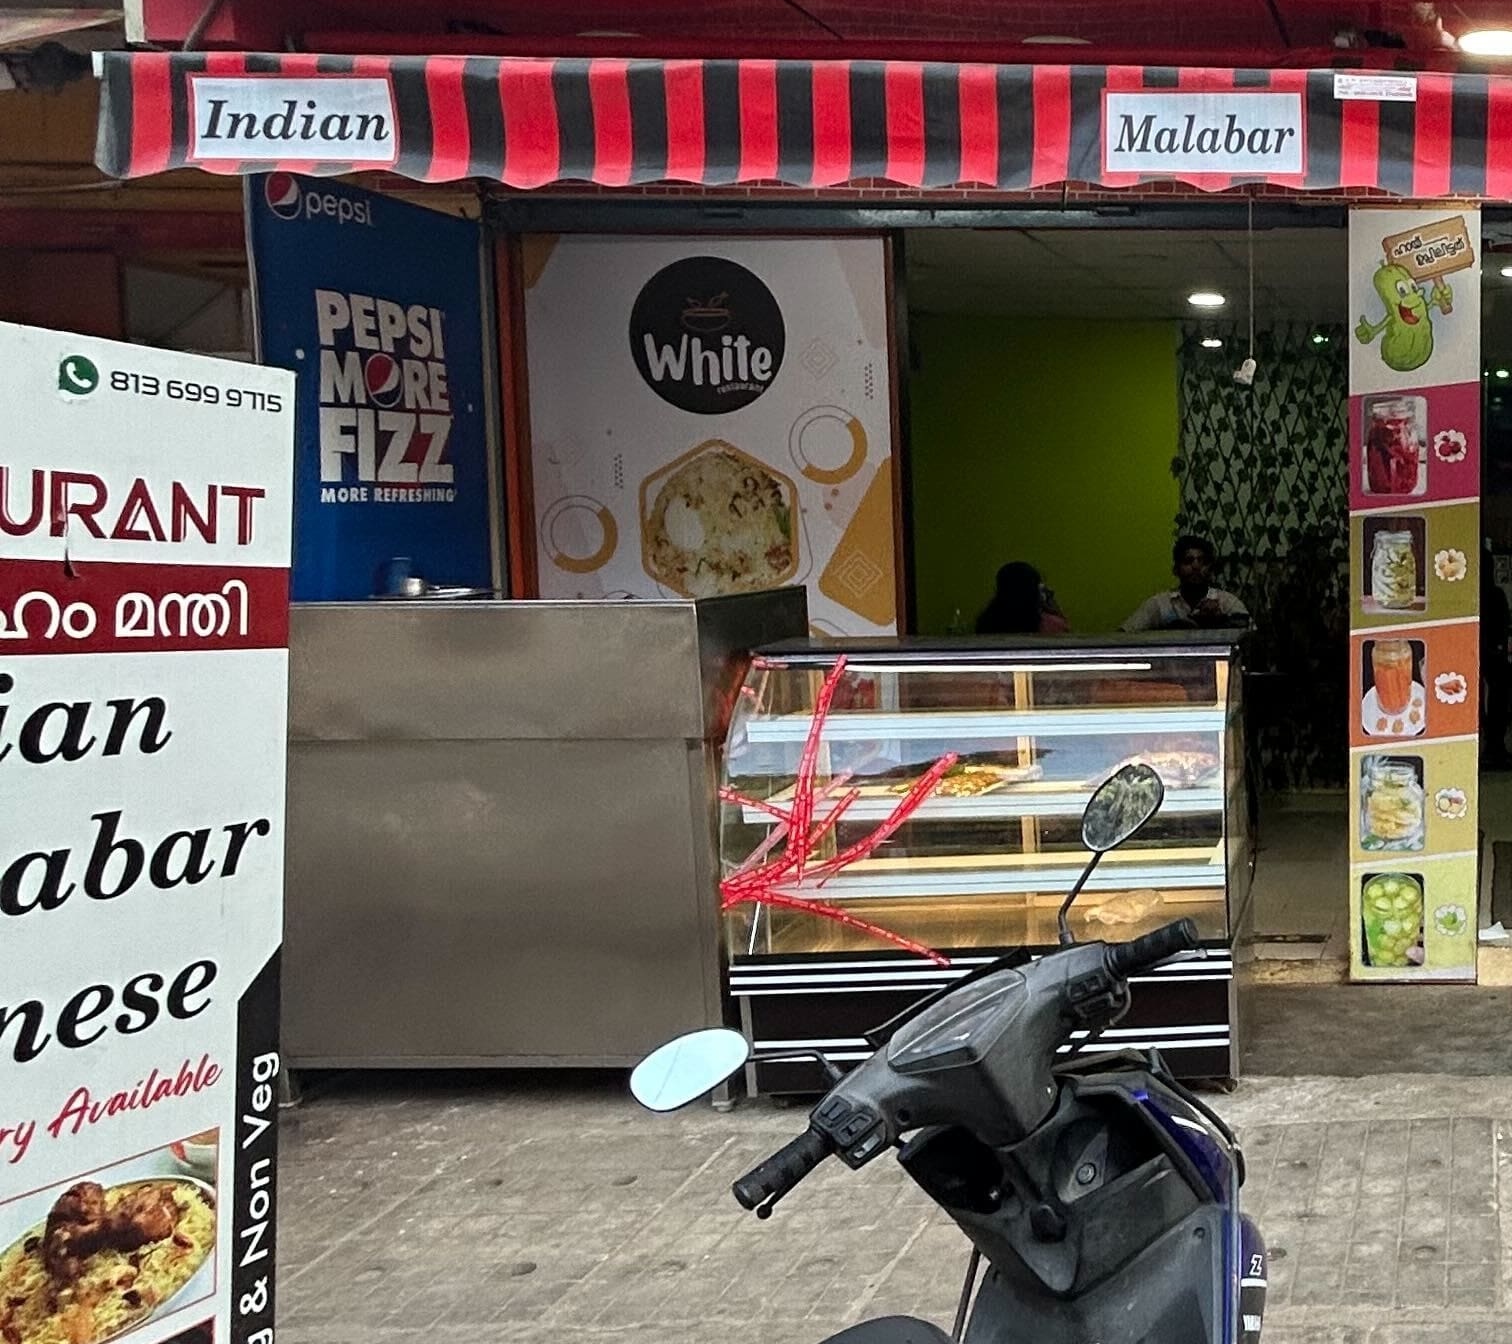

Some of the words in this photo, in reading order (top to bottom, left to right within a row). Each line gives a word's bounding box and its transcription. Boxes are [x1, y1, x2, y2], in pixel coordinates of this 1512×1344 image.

[201, 98, 390, 143] Indian
[1113, 113, 1296, 155] Malabar
[304, 189, 373, 225] pepsi
[314, 288, 445, 359] PEPSI
[319, 350, 450, 411] MORE
[643, 333, 773, 386] White
[110, 370, 159, 396] 813
[166, 380, 220, 405] 699
[226, 389, 283, 413] 9715
[319, 408, 455, 484] FIZZ
[320, 486, 368, 504] MORE
[374, 487, 456, 504] REFRESHING
[47, 1053, 223, 1139] Available
[242, 1051, 281, 1149] Veg
[239, 1158, 271, 1268] Non
[239, 1276, 269, 1315] &
